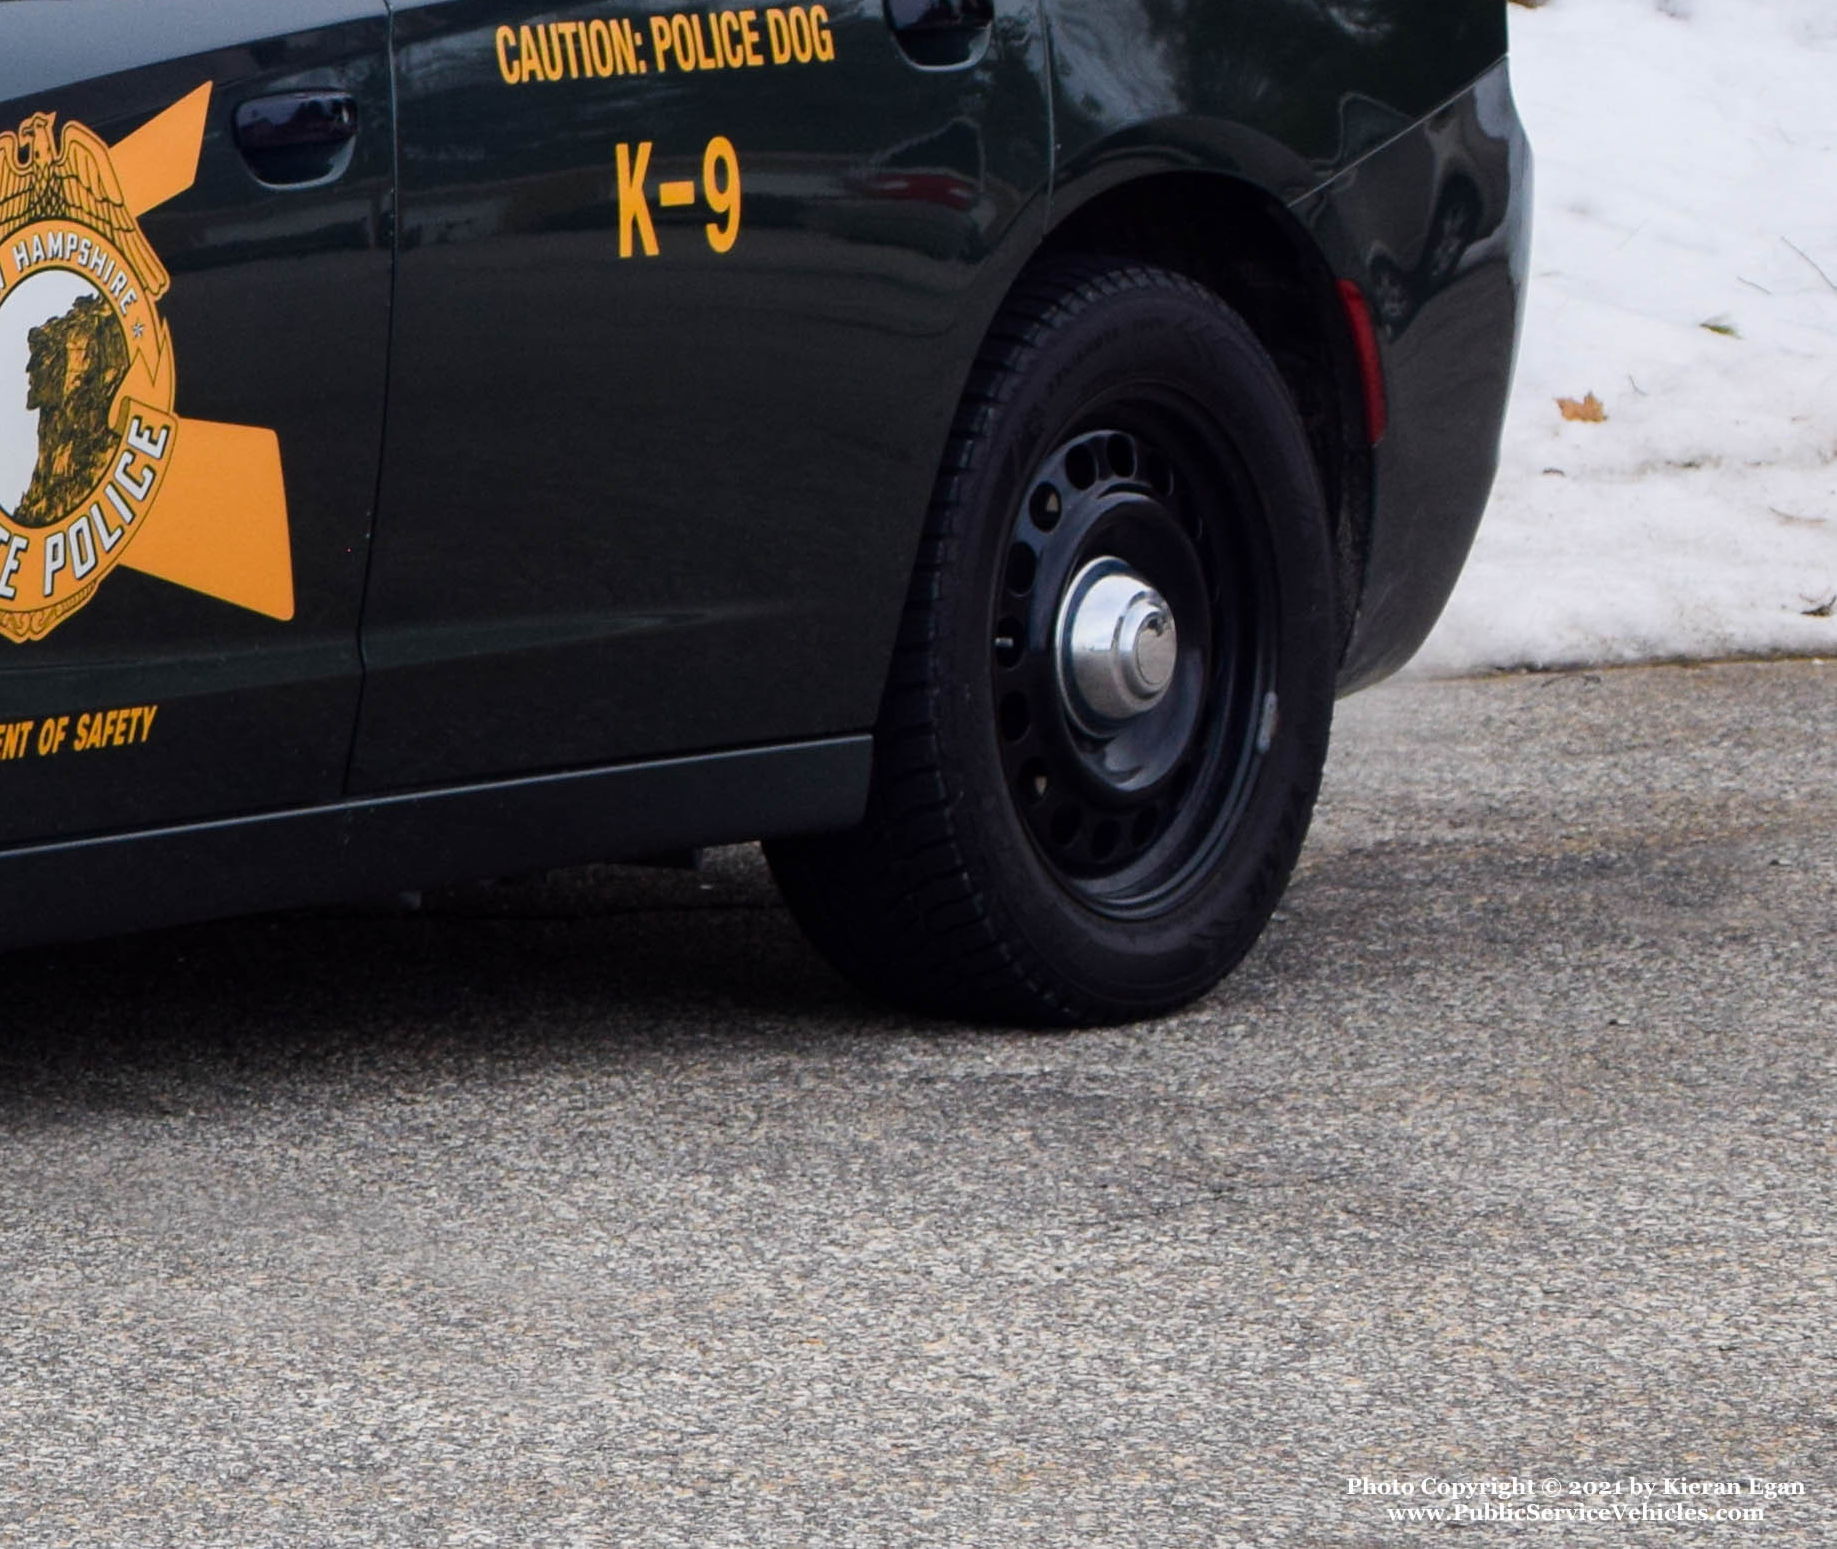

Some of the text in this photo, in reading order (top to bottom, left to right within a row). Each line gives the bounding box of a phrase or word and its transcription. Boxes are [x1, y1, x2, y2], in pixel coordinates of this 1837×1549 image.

[495, 4, 835, 85] CAUTION: POLICE DOG
[615, 135, 742, 259] K-9
[11, 232, 138, 315] HAMPSHIRE
[41, 412, 170, 598] POLICE
[37, 715, 70, 756] OF
[73, 705, 158, 752] SAFETY
